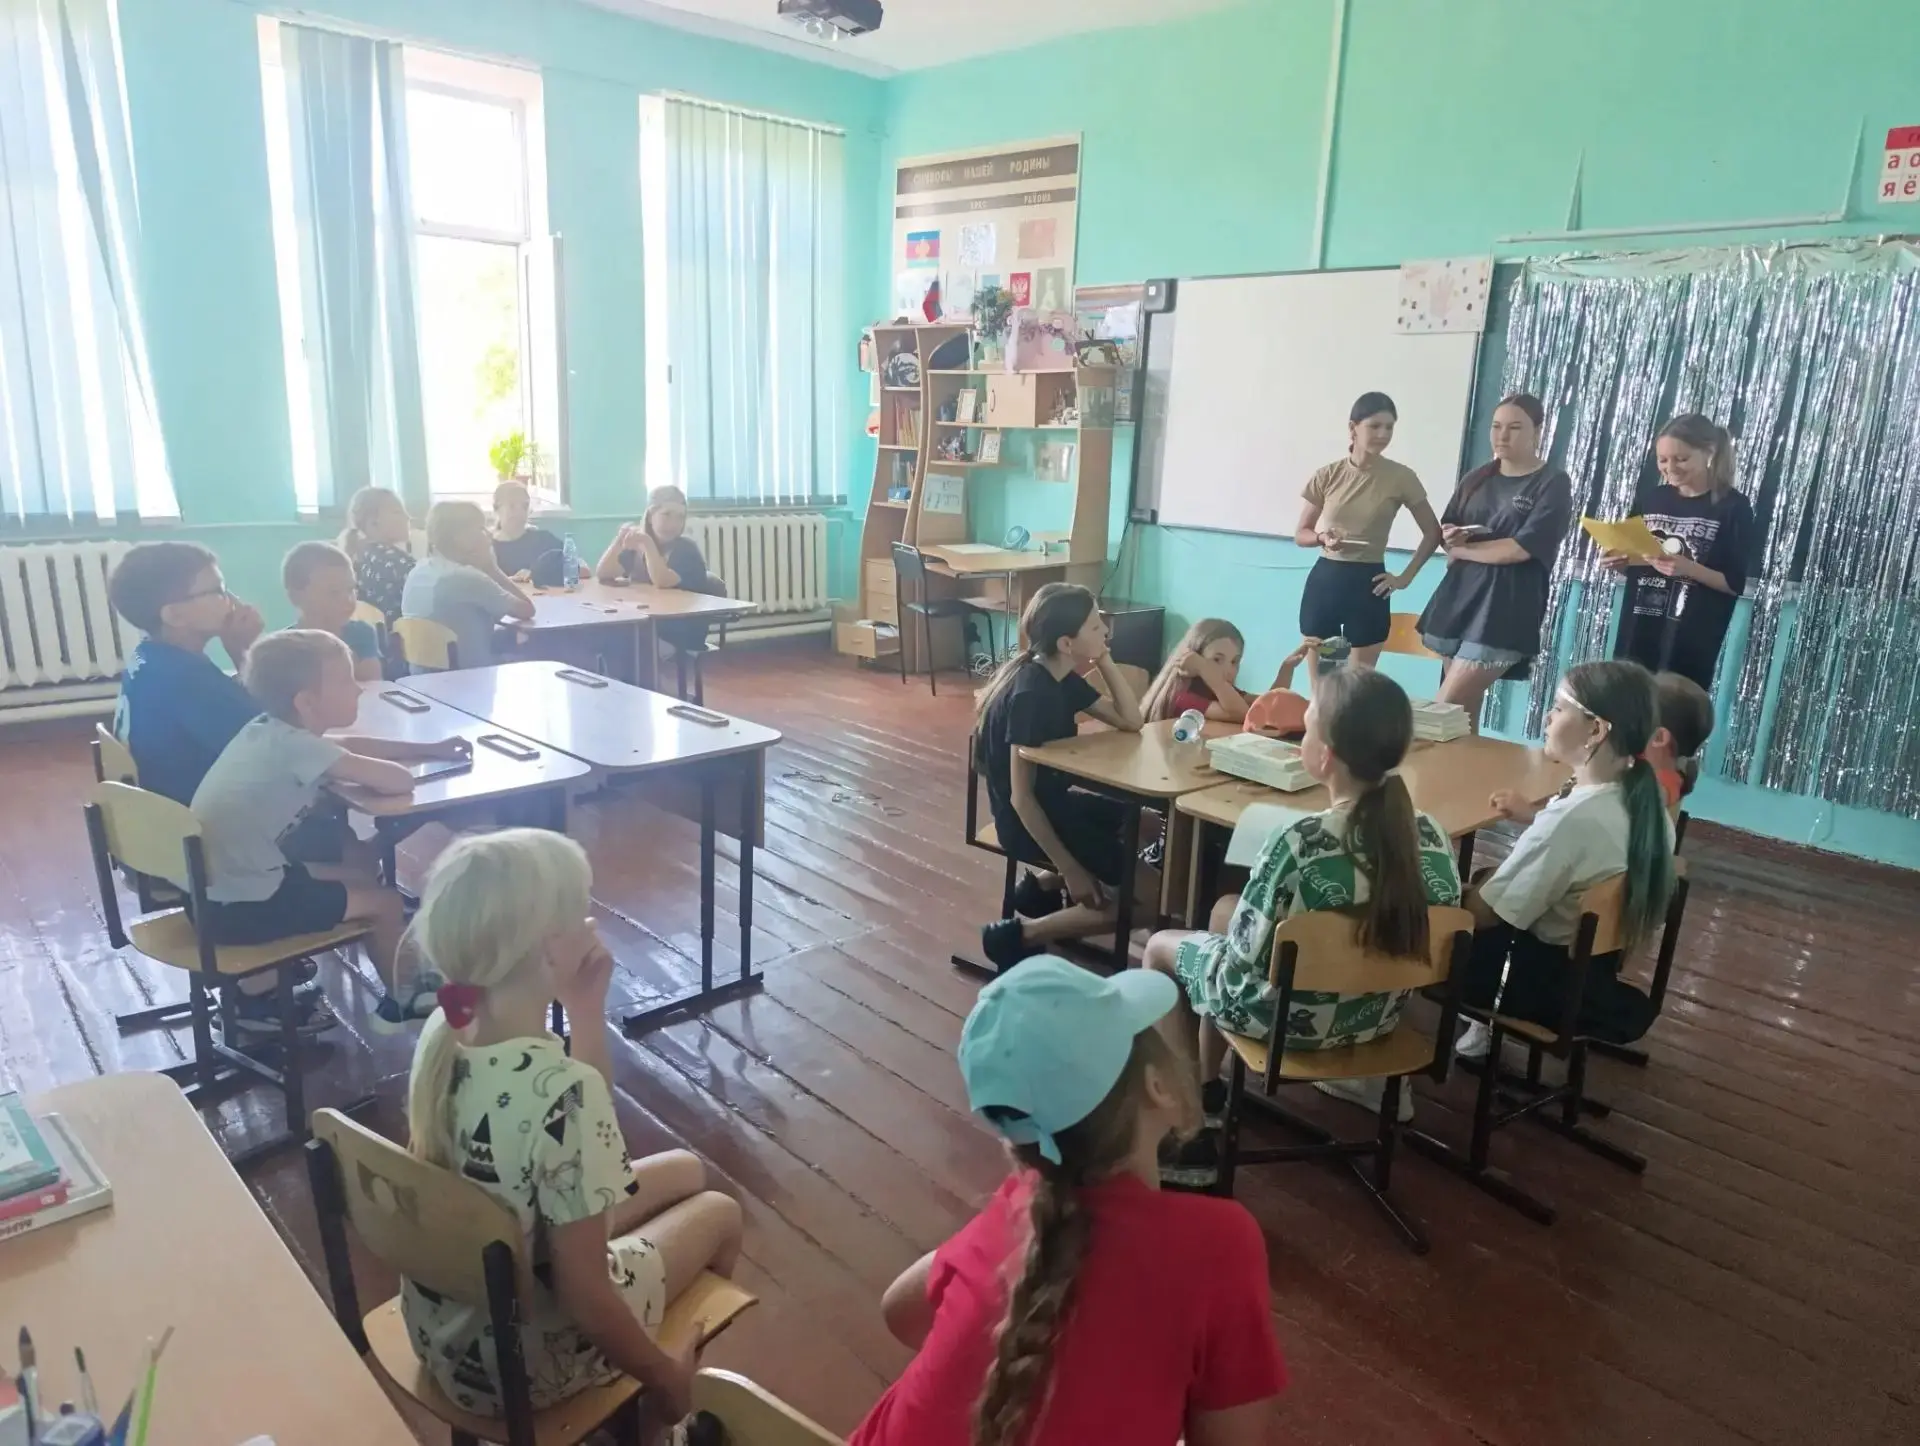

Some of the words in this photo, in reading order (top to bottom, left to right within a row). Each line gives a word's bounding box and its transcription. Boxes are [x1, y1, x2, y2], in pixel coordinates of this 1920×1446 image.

[964, 162, 993, 179] НАШЕЙ
[1010, 157, 1049, 174] РОДИНЫ
[1023, 192, 1052, 204] РАЙОНА
